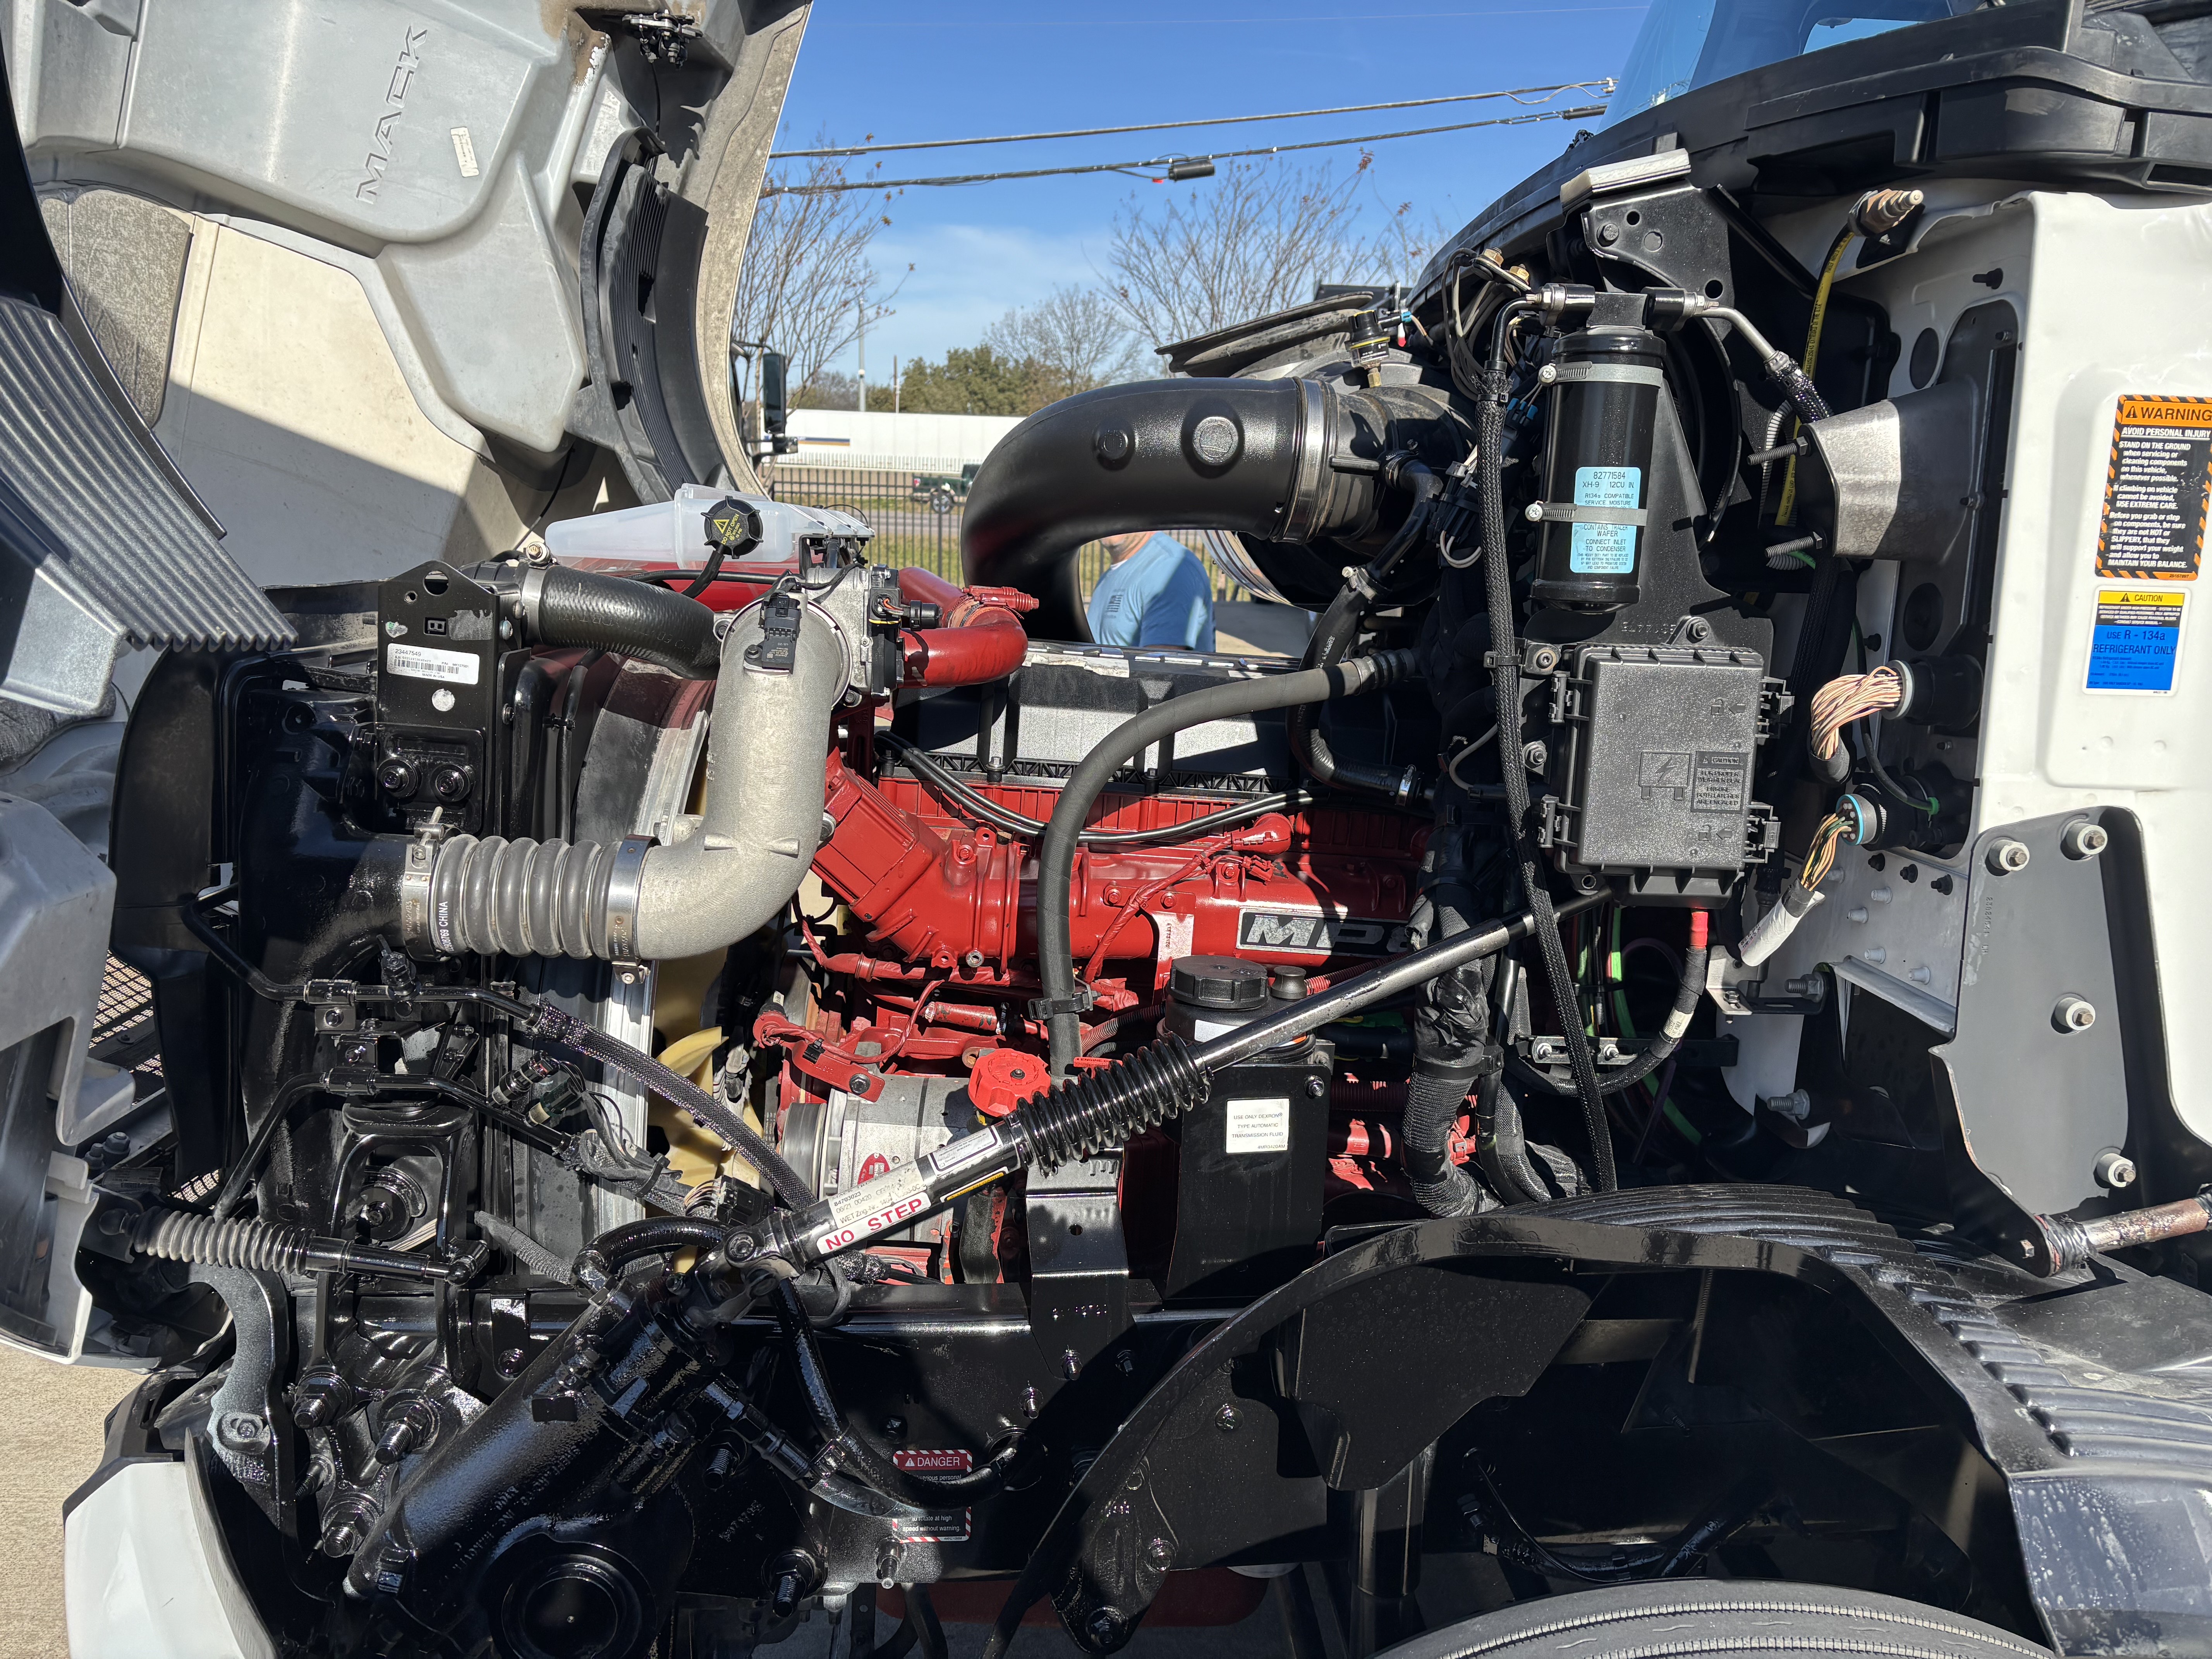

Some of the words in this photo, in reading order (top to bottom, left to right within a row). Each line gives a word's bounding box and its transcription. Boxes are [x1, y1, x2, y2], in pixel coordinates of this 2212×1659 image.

[356, 25, 427, 204] MACK
[2141, 407, 2212, 421] WARNING
[2121, 427, 2144, 435] AVOID
[2146, 428, 2183, 436] PERSONAL
[2119, 485, 2146, 493] climbing
[730, 514, 739, 527] OPEN
[2124, 630, 2131, 639] R
[2143, 630, 2166, 640] 134a
[2093, 644, 2152, 654] REFRIGERANT
[2154, 646, 2176, 654] ONLY
[439, 901, 448, 926] CHINA
[834, 1192, 861, 1206] 84703023
[836, 1204, 851, 1213] 06/21
[840, 1212, 855, 1223] WET
[825, 1230, 854, 1250] NO
[867, 1199, 922, 1231] STEP
[917, 1457, 960, 1467] DANGER
